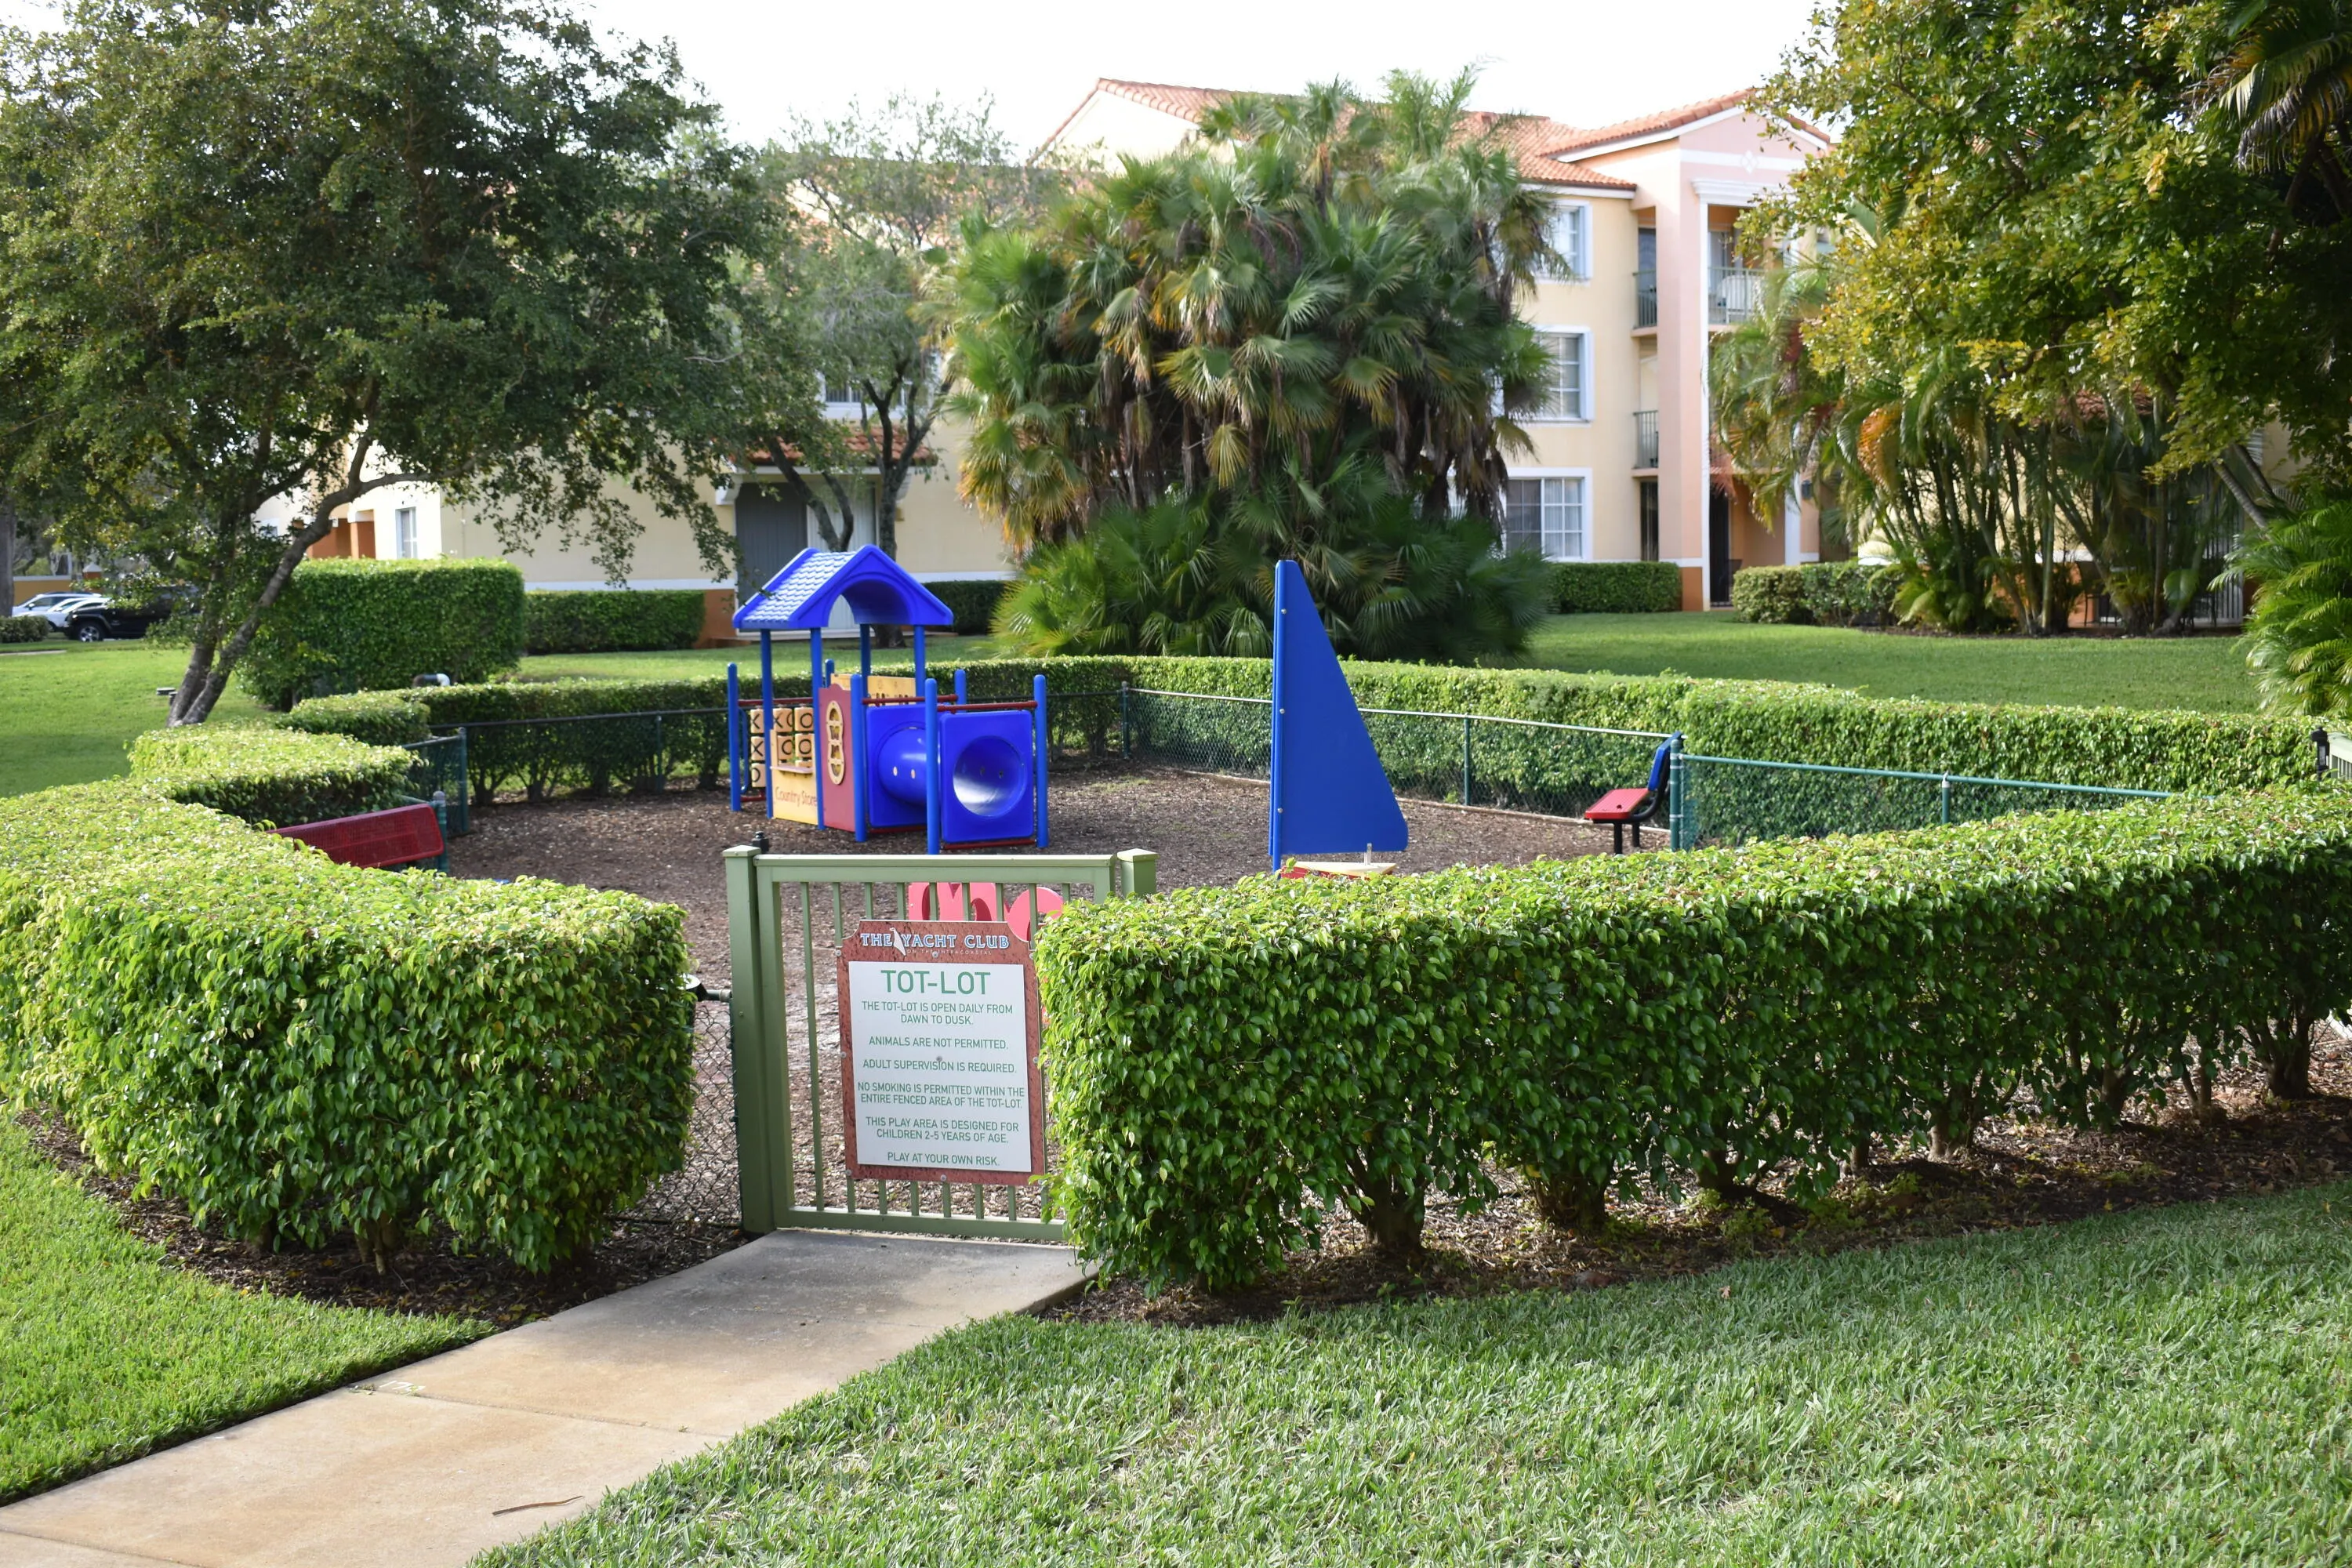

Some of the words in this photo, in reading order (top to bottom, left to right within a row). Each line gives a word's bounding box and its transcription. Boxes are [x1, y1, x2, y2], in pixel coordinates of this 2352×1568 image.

[775, 786, 800, 807] Country
[860, 933, 892, 947] THE
[901, 934, 956, 948] YACHT
[964, 935, 1010, 949] CLUB
[880, 970, 991, 994] TOT-LOT
[862, 1000, 880, 1011] THE
[881, 1001, 917, 1011] TOT-LOT
[920, 1003, 928, 1011] IS
[931, 1003, 956, 1012] OPEN
[959, 1004, 984, 1013] DAILY
[986, 1004, 1013, 1014] FROM
[901, 1014, 928, 1024] DAWN
[931, 1014, 942, 1024] TO
[946, 1015, 974, 1025] DUSK.
[869, 1036, 910, 1046] ANIMALS
[913, 1037, 931, 1047] ARE
[933, 1038, 952, 1047] NOT
[954, 1039, 1009, 1049] PERMITTED.
[862, 1059, 891, 1069] ADULT
[894, 1060, 954, 1071] SUPERVISION
[956, 1062, 965, 1071] IS
[968, 1062, 1017, 1073] REQUIRED.
[858, 1082, 869, 1091] NO
[872, 1082, 912, 1092] SMOKING
[913, 1083, 922, 1093] IS
[924, 1084, 972, 1095] PERMITTED
[974, 1086, 1005, 1096] WITHIN
[1007, 1087, 1025, 1097] THE
[861, 1094, 891, 1103] ENTIRE
[893, 1094, 927, 1105] FENCED
[928, 1096, 953, 1105] AREA
[954, 1097, 966, 1105] OF
[968, 1098, 985, 1107] THE
[986, 1098, 1022, 1109] TOT-LOT.
[866, 1116, 886, 1127] THIS
[888, 1117, 911, 1127] PLAY
[913, 1119, 938, 1128] AREA
[940, 1120, 949, 1129] IS
[951, 1120, 997, 1131] DESIGNED
[1000, 1122, 1019, 1131] FOR
[877, 1128, 923, 1139] CHILDREN
[924, 1131, 939, 1140] 2-5
[941, 1131, 971, 1142] YEARS
[973, 1133, 985, 1142] OF
[987, 1134, 1009, 1143] AGE.
[887, 1152, 909, 1162] PLAY
[912, 1153, 923, 1162] AT
[925, 1153, 949, 1163] YOUR
[951, 1155, 973, 1164] OWN
[975, 1156, 1000, 1166] RISK.
